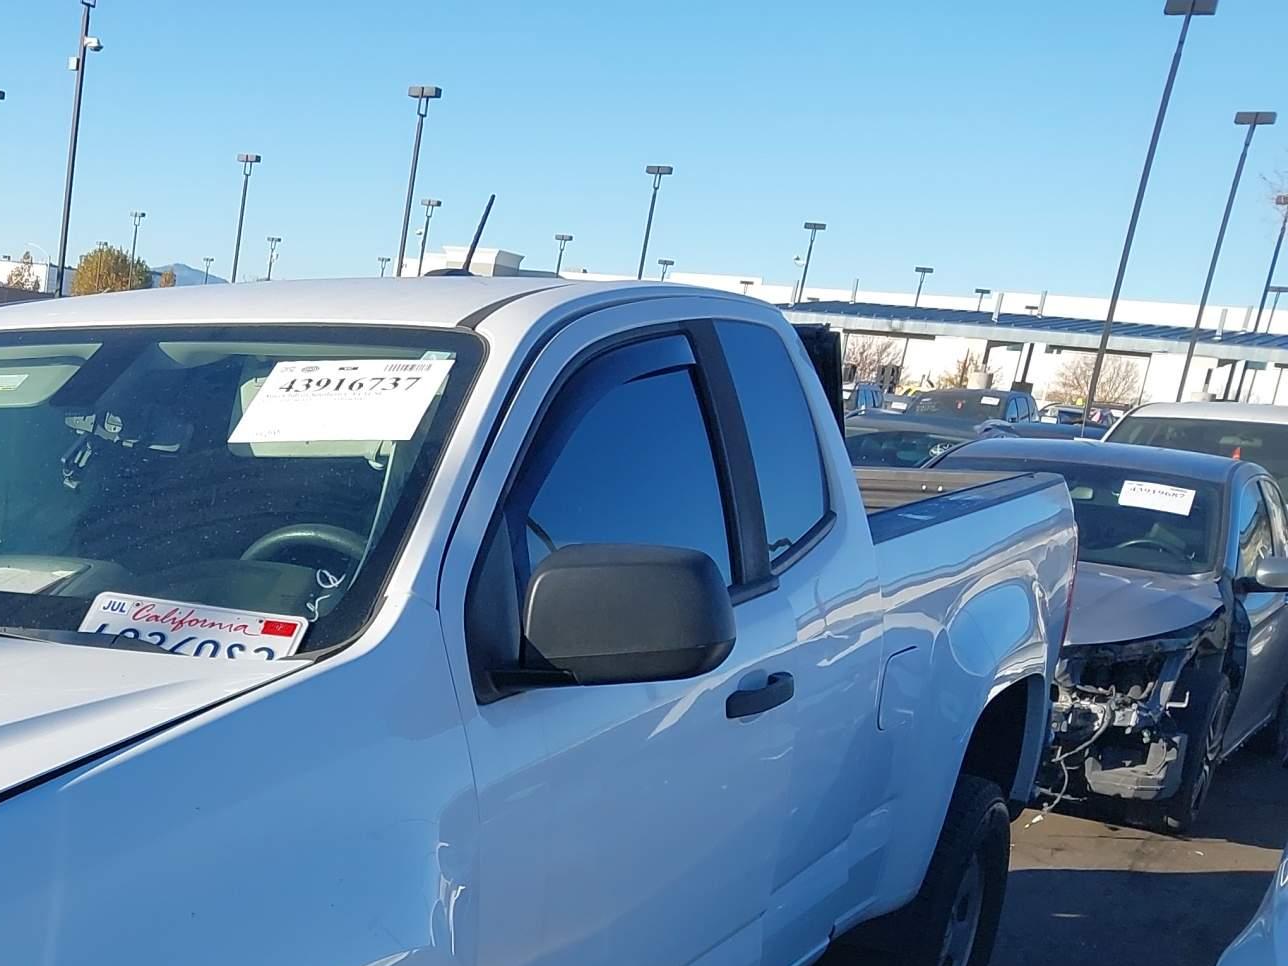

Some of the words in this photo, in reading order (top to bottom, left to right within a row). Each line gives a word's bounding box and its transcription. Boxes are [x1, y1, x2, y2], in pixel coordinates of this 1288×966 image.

[278, 376, 422, 393] 43916737
[102, 600, 127, 613] JUL
[130, 603, 261, 637] California
